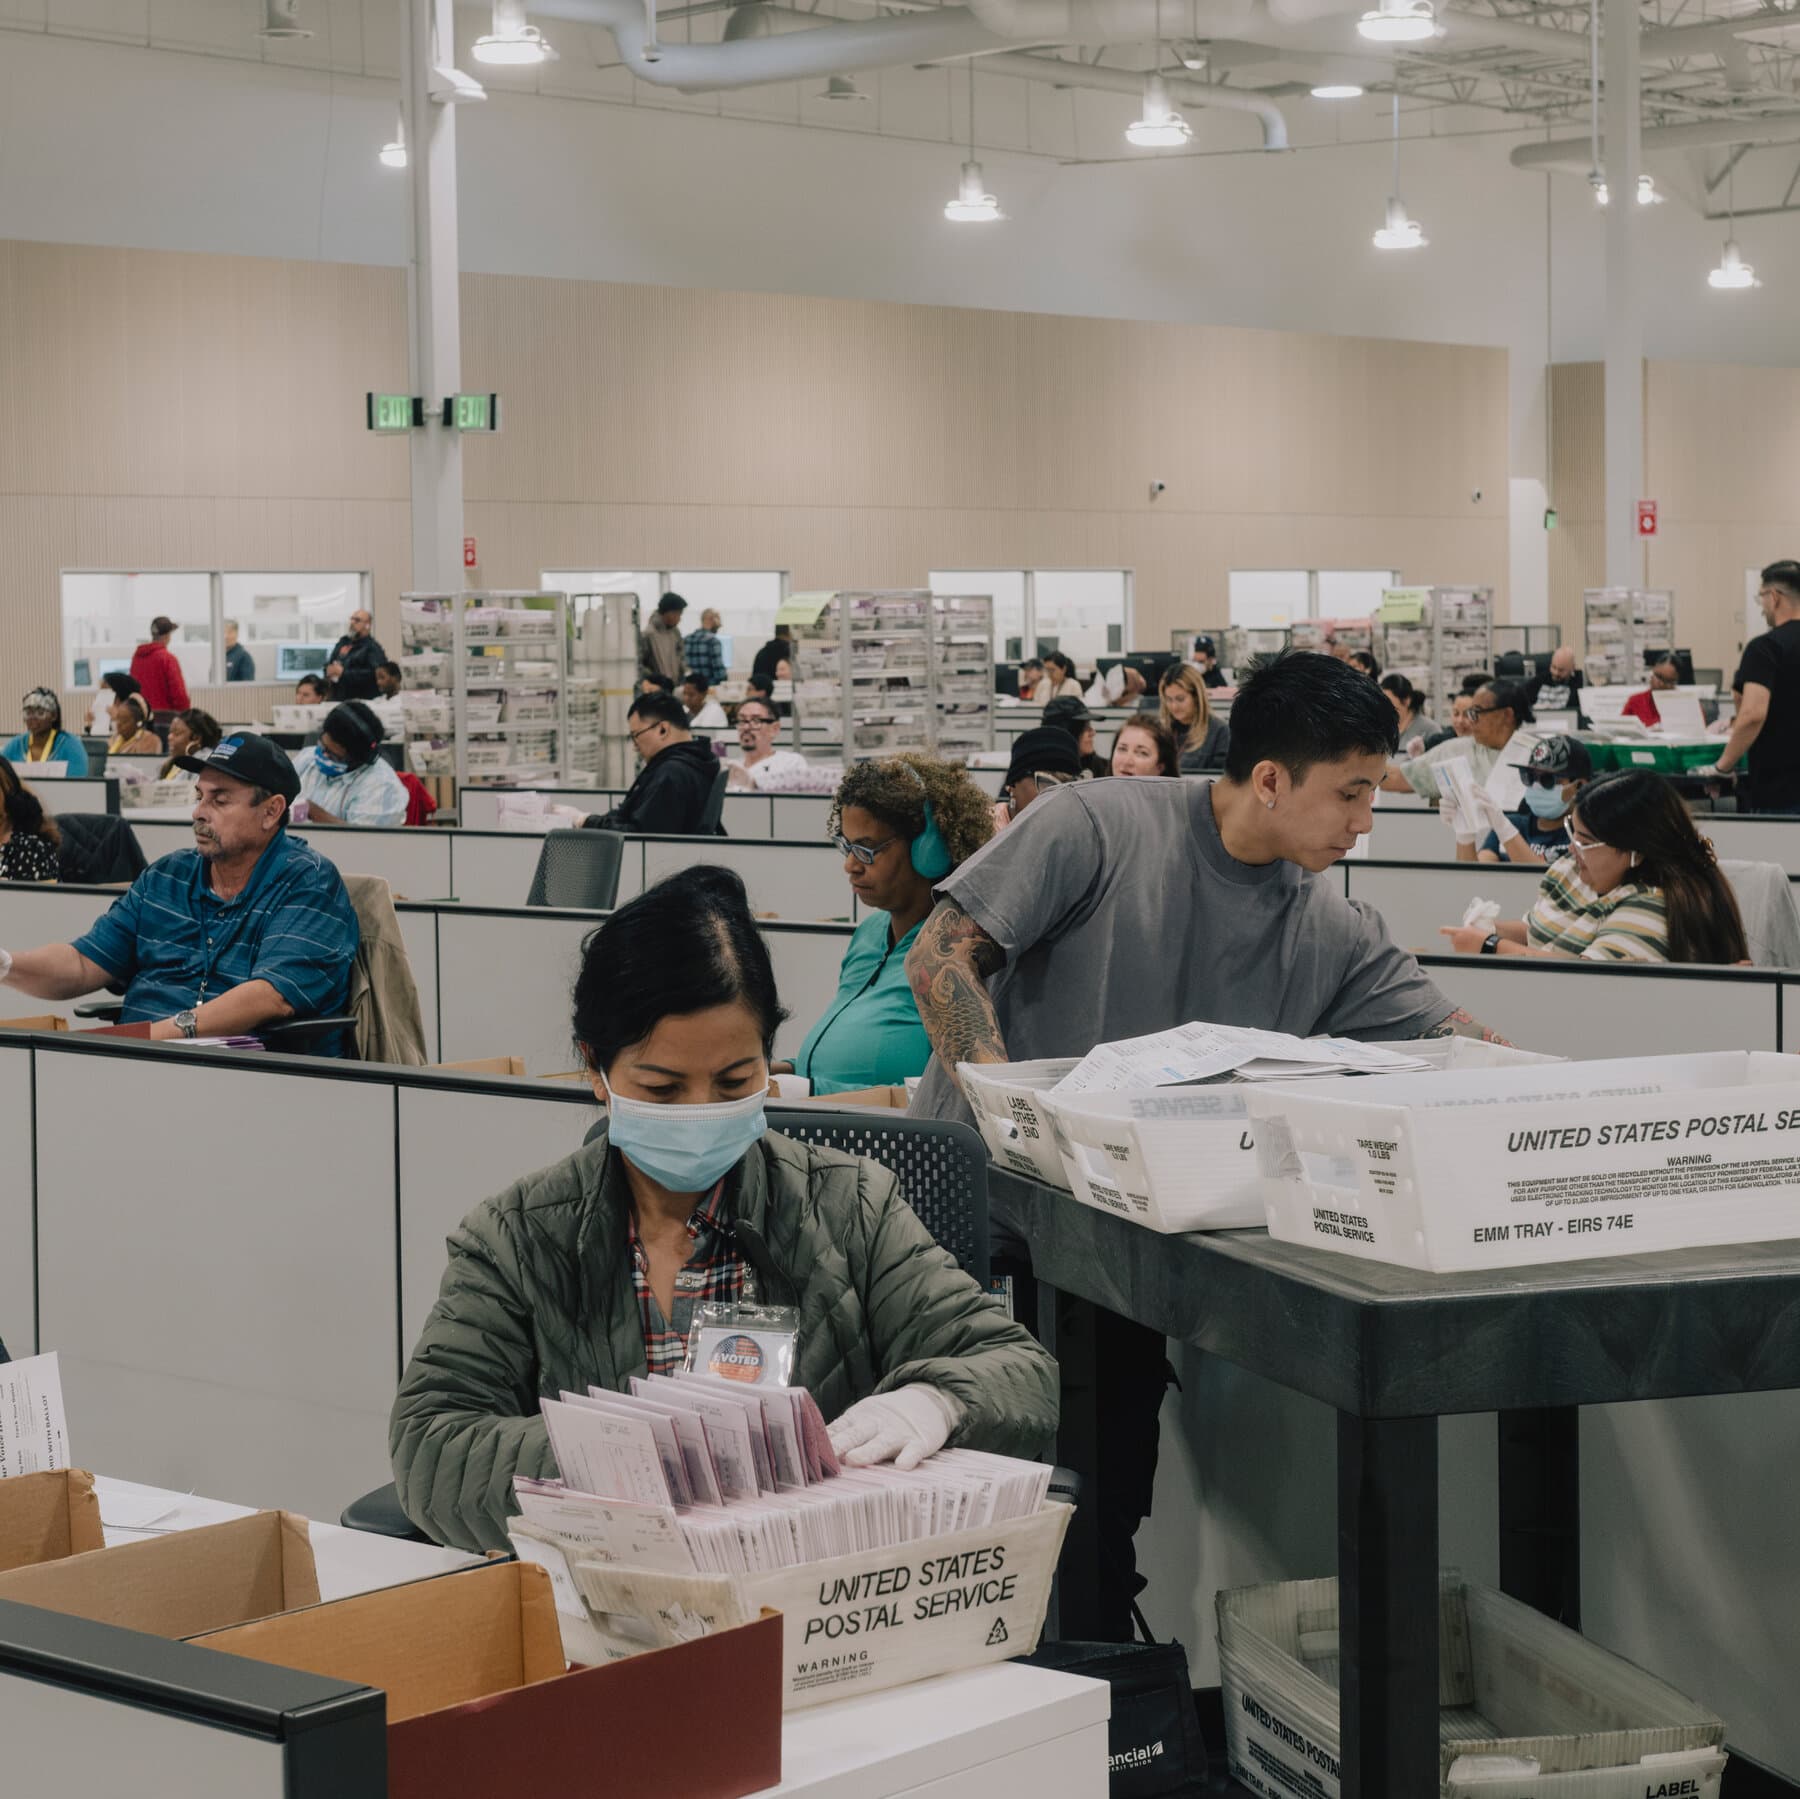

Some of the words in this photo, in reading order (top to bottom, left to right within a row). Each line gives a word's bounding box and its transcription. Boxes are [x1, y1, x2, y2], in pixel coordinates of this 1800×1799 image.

[379, 397, 408, 428] EXIT
[458, 397, 485, 428] EXIT
[1006, 1096, 1032, 1112] LABEL
[1013, 1111, 1040, 1126] OTHER
[1022, 1126, 1040, 1139] END
[1507, 1127, 1591, 1152] UNITED
[1597, 1120, 1680, 1146] STATES
[1685, 1113, 1768, 1138] POSTAL
[1357, 1140, 1372, 1148] TARE
[1374, 1141, 1398, 1152] WEIGHT
[1378, 1151, 1390, 1160] LBS
[1667, 1154, 1712, 1166] WARNING
[1617, 1170, 1648, 1178] RECYCLED
[1594, 1186, 1632, 1194] TECHNOLOGY
[1313, 1208, 1340, 1223] UNITED
[1340, 1213, 1368, 1228] STATES
[1474, 1226, 1510, 1242] EMM
[1514, 1222, 1554, 1239] TRAY
[1568, 1216, 1602, 1234] EIRS
[1607, 1214, 1634, 1230] 74E
[1314, 1221, 1342, 1236] POSTAL
[1343, 1227, 1376, 1242] SERVICE
[720, 1353, 760, 1366] VOTED
[42, 1395, 51, 1428] BALLOT
[819, 1566, 911, 1606] UNITED
[918, 1546, 1006, 1586] STATES
[804, 1602, 904, 1644] POSTAL
[914, 1574, 1018, 1620] SERVICE
[798, 1650, 868, 1674] WARNING
[1242, 1692, 1272, 1728] UNITED
[1272, 1716, 1306, 1754] STATES
[1130, 1759, 1152, 1768] UNION
[1646, 1779, 1700, 1799] LABEL
